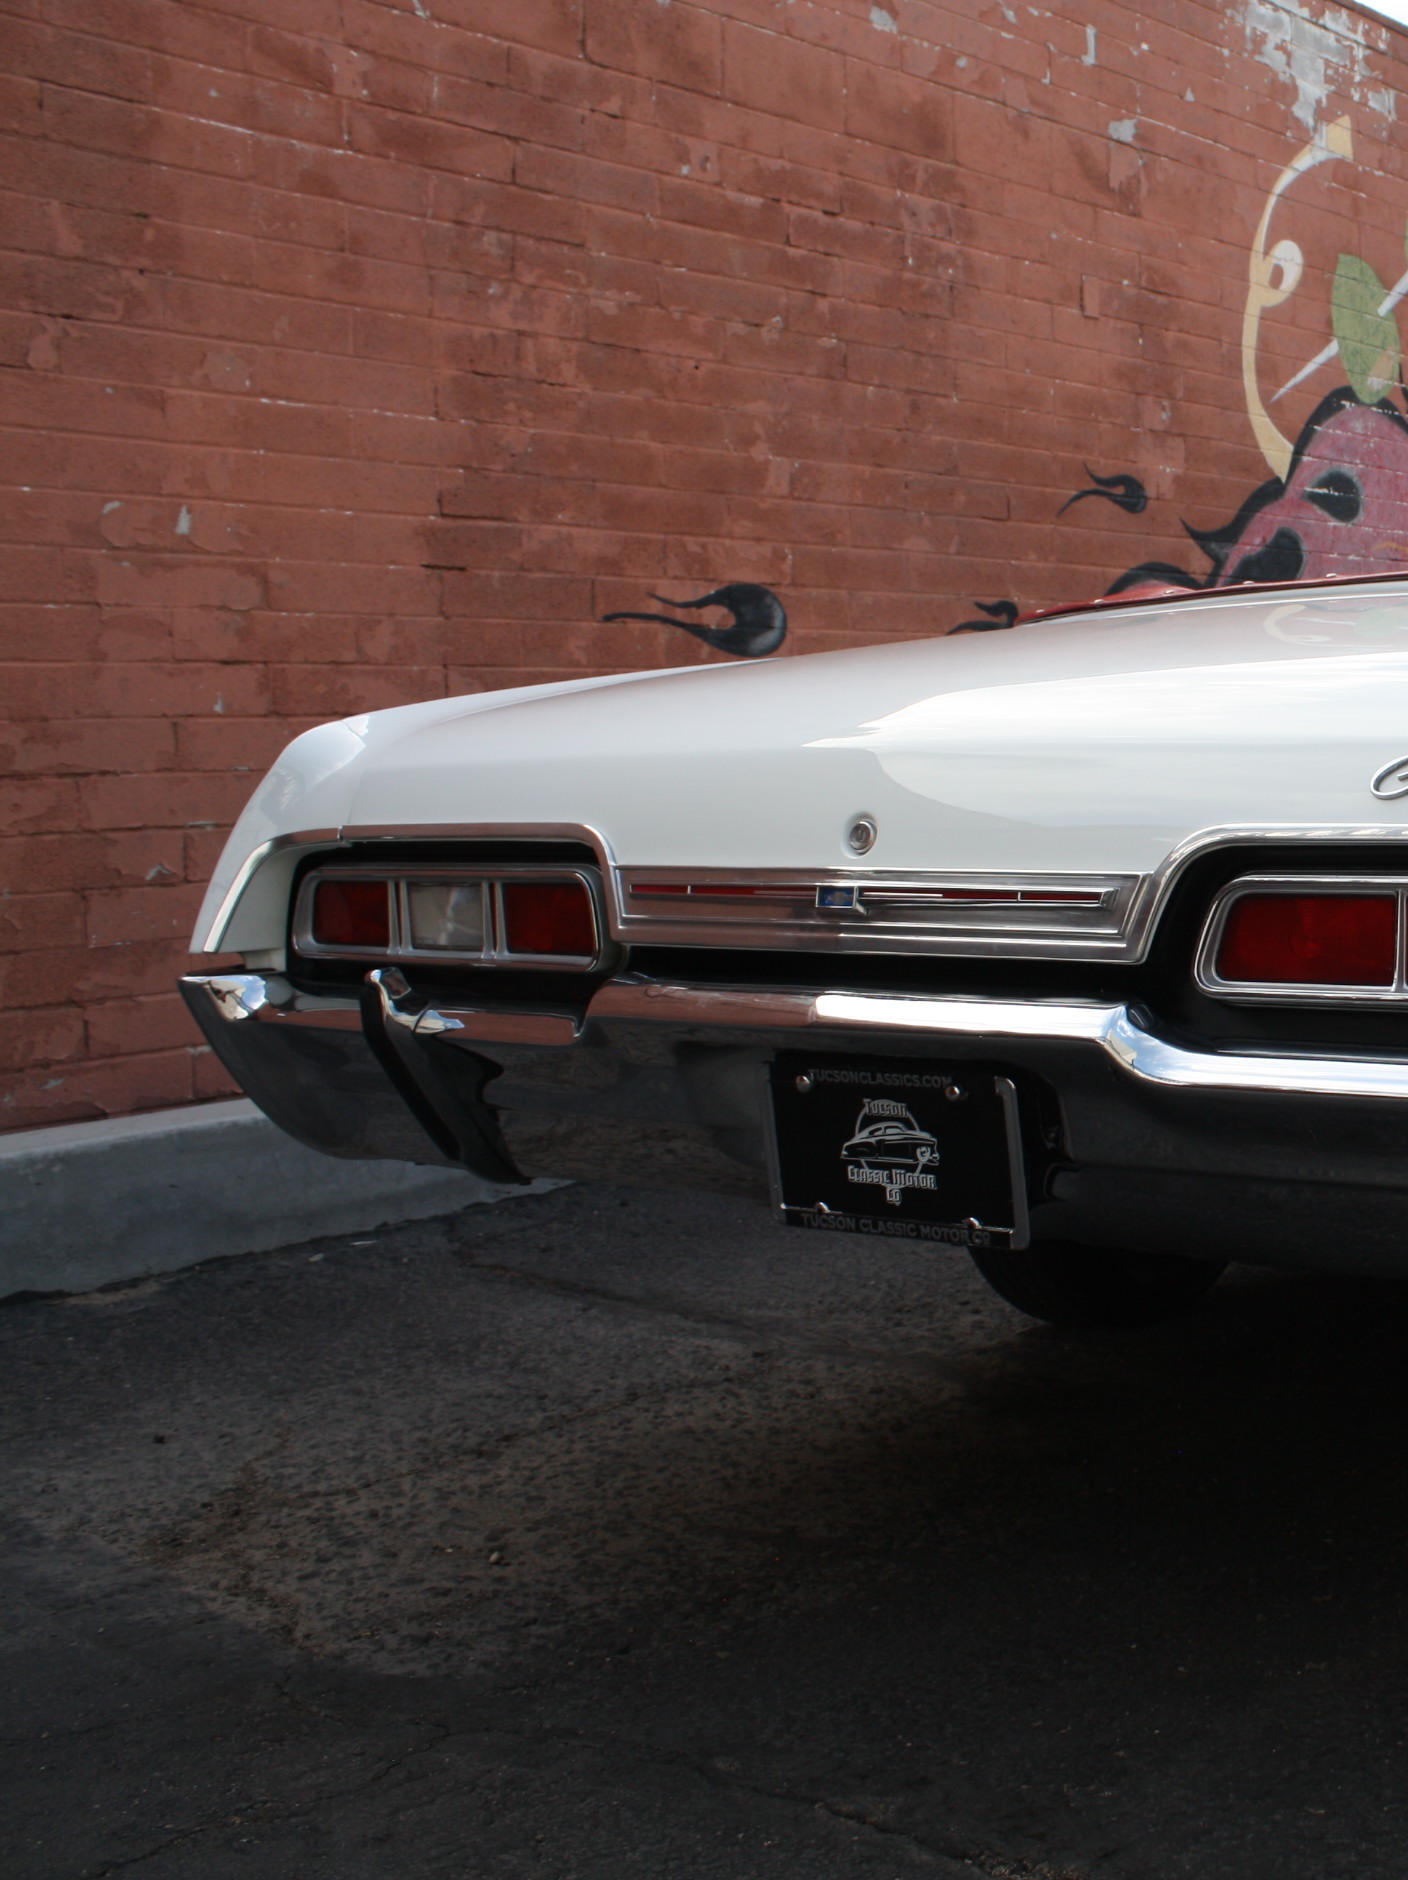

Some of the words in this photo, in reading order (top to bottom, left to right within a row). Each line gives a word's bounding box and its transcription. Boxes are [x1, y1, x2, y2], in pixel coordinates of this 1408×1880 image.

[801, 1212, 857, 1230] TUCSON
[859, 1220, 918, 1237] CLASSIC
[919, 1225, 969, 1244] MOTOR
